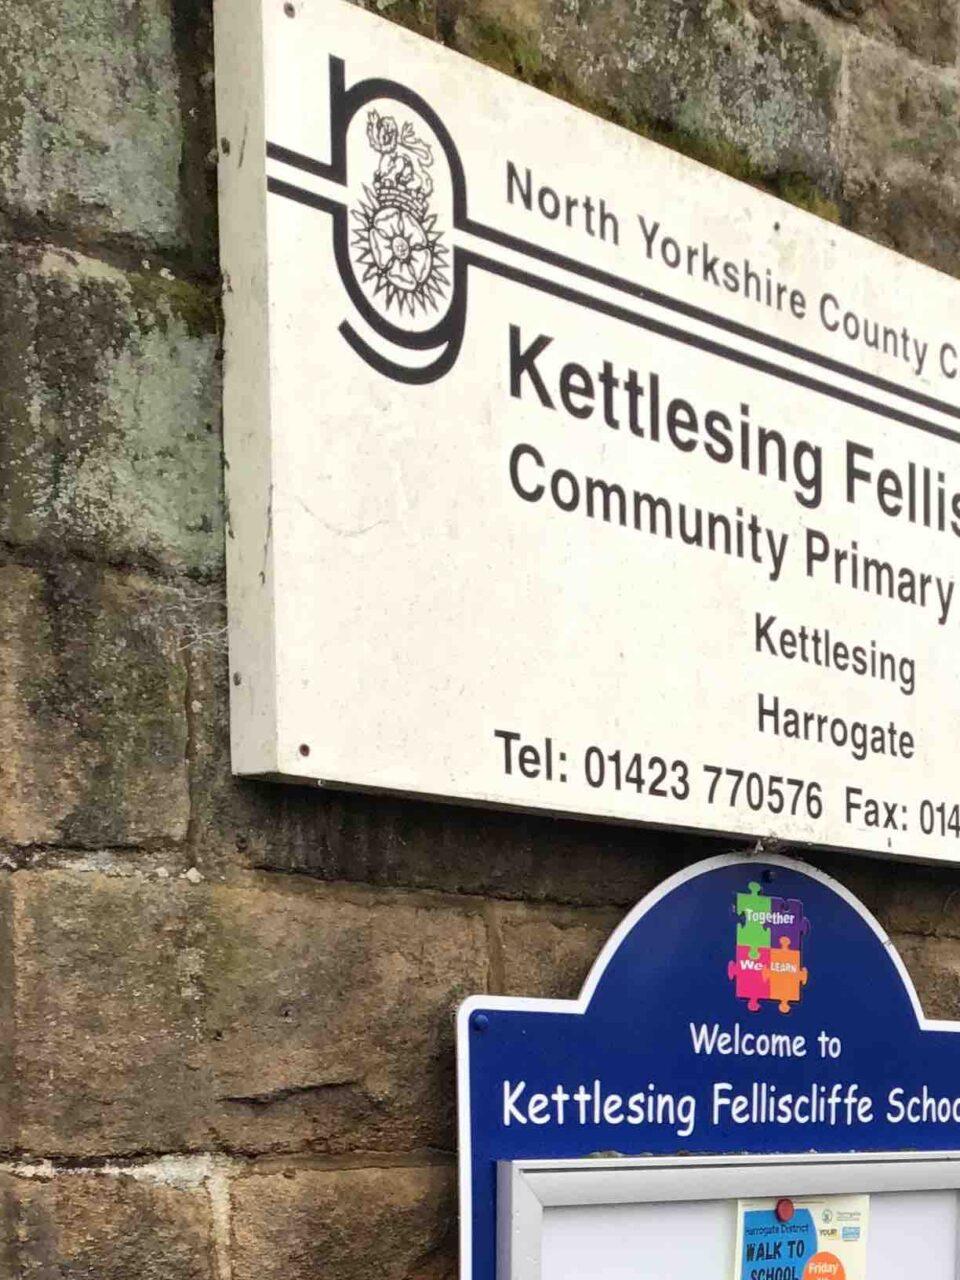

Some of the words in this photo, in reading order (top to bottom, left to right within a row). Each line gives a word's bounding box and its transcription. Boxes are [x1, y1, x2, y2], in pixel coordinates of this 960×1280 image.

[506, 161, 619, 246] North
[638, 216, 806, 320] Yorkshire
[820, 292, 928, 378] County
[508, 324, 823, 510] Kettlesing
[509, 443, 789, 583] Community
[805, 528, 956, 627] Primary
[754, 611, 916, 697] Kettlesing
[757, 692, 915, 762] Harrogate
[494, 729, 568, 784] Tel:
[584, 746, 691, 802] 01423
[703, 764, 824, 820] 770576
[844, 786, 908, 832] Fax:
[745, 908, 795, 926] Together
[740, 959, 763, 971] We
[770, 961, 797, 973] LEARN
[689, 1022, 807, 1059] Welcome
[817, 1030, 842, 1060] to
[503, 1079, 697, 1138] Kettlesing
[712, 1081, 875, 1127] Felliscliffe
[746, 1241, 782, 1261] WALK
[787, 1239, 805, 1259] TO
[808, 1262, 838, 1276] Friday
